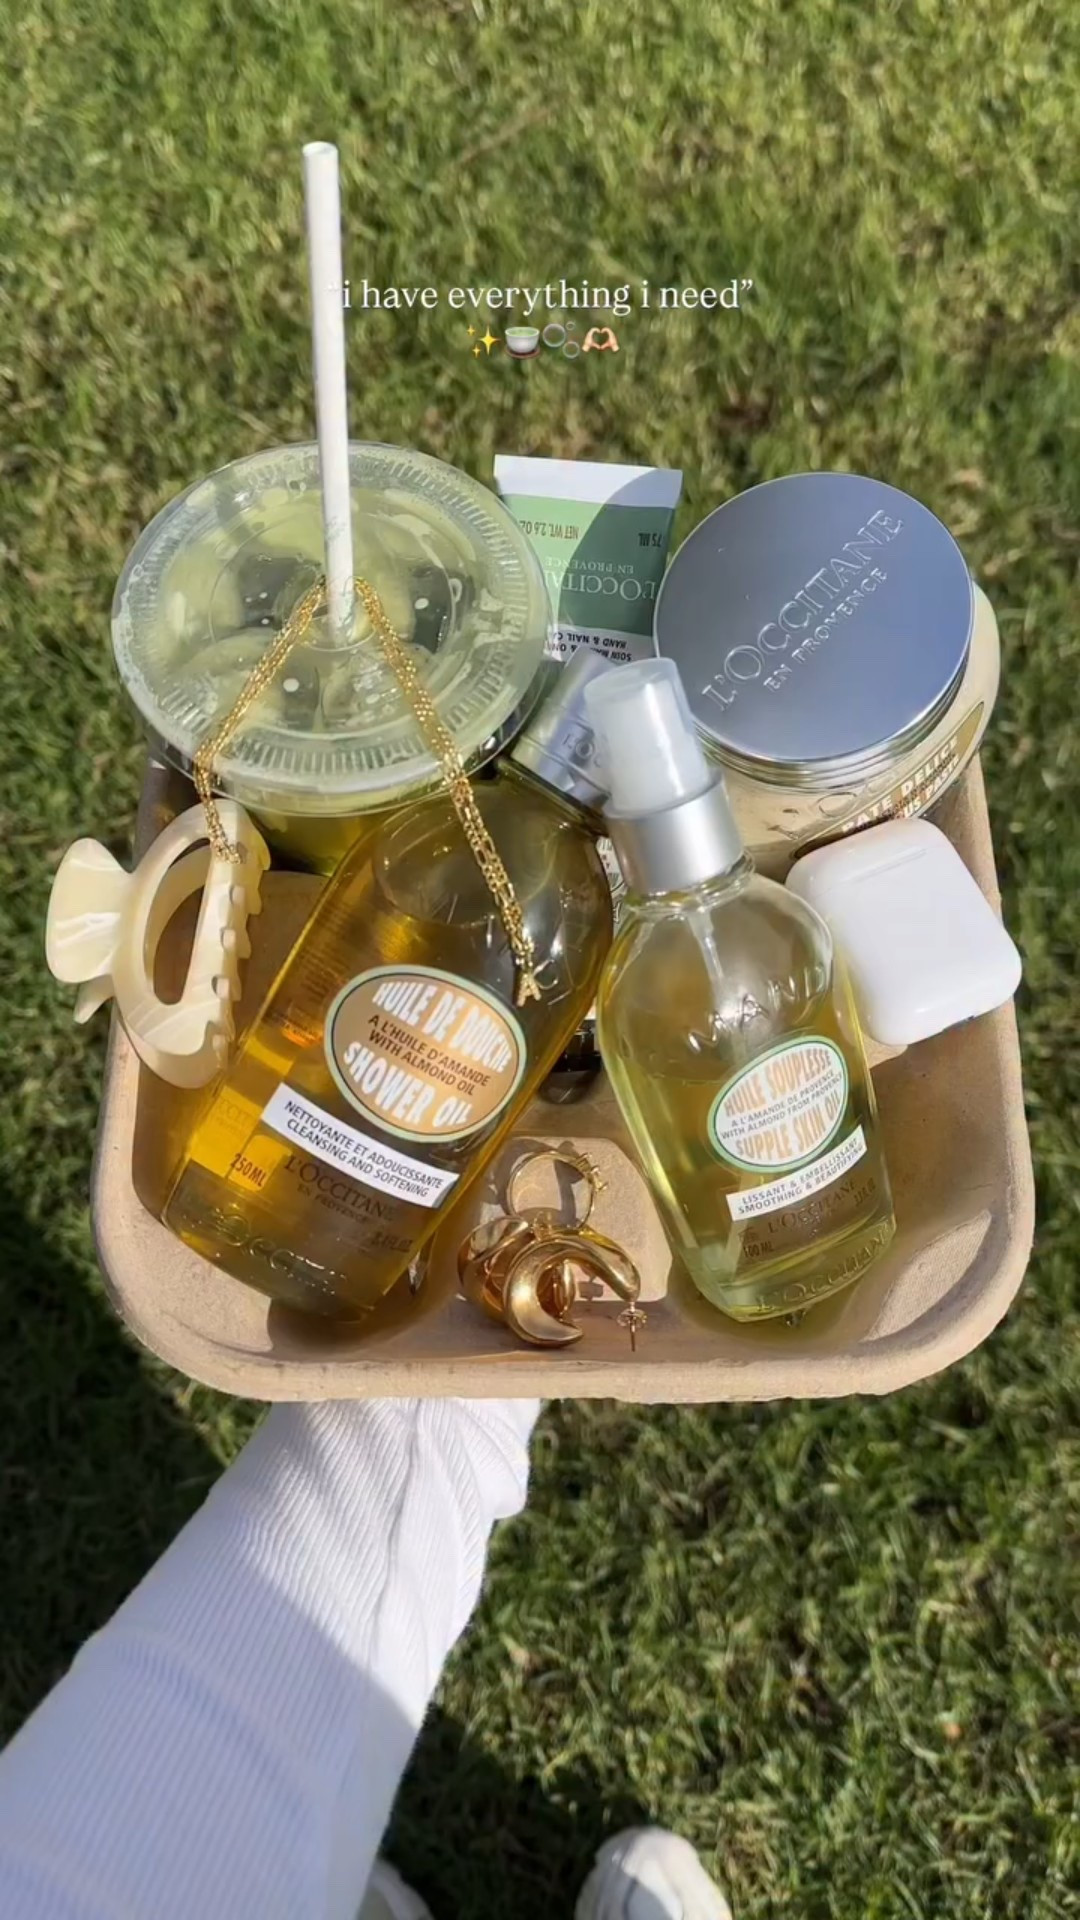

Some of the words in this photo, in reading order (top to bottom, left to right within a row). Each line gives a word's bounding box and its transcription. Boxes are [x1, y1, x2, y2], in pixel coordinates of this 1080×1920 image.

[546, 556, 614, 573] PROVENCE
[563, 526, 580, 540] NET
[616, 564, 634, 575] EN
[566, 632, 590, 644] NAIL
[593, 635, 600, 646] &
[602, 637, 628, 650] HAND
[763, 663, 793, 693] EN
[791, 566, 888, 664] PROVENCE
[372, 981, 438, 1027] HUILE
[422, 990, 466, 1044] DE
[368, 1014, 381, 1028] A
[380, 1019, 425, 1056] L'HUILE
[427, 1048, 491, 1087] D'AMANDE
[368, 1029, 401, 1057] WITH
[400, 1050, 458, 1087] ALMOND
[456, 1079, 476, 1097] OIL
[343, 1040, 437, 1126] SHOWER
[431, 1095, 474, 1128] OIL
[723, 1073, 768, 1118] HUILE
[764, 1047, 833, 1101] SOUPLESSE
[731, 1119, 739, 1129] A
[740, 1102, 786, 1126] L'AMANDE
[787, 1094, 799, 1106] DE
[800, 1071, 835, 1098] PROVENCE
[284, 1100, 356, 1150] NETTOYANTE
[353, 1144, 370, 1161] ET
[368, 1150, 446, 1190] ADOUCISSANTE
[721, 1127, 746, 1140] WITH
[748, 1111, 786, 1132] ALMOND
[787, 1098, 811, 1119] FROM
[735, 1122, 794, 1161] SUPPLE
[792, 1103, 827, 1152] SKIN
[286, 1118, 349, 1165] CLEANSING
[348, 1155, 374, 1175] AND
[373, 1166, 430, 1199] SOFTENING
[738, 1187, 804, 1215] SMOOTHING
[805, 1181, 813, 1191] &
[814, 1141, 865, 1187] BEAUTIFYING
[741, 1183, 787, 1206] LISSANT
[789, 1178, 797, 1189] &
[799, 1137, 859, 1184] EMBELLISSANT
